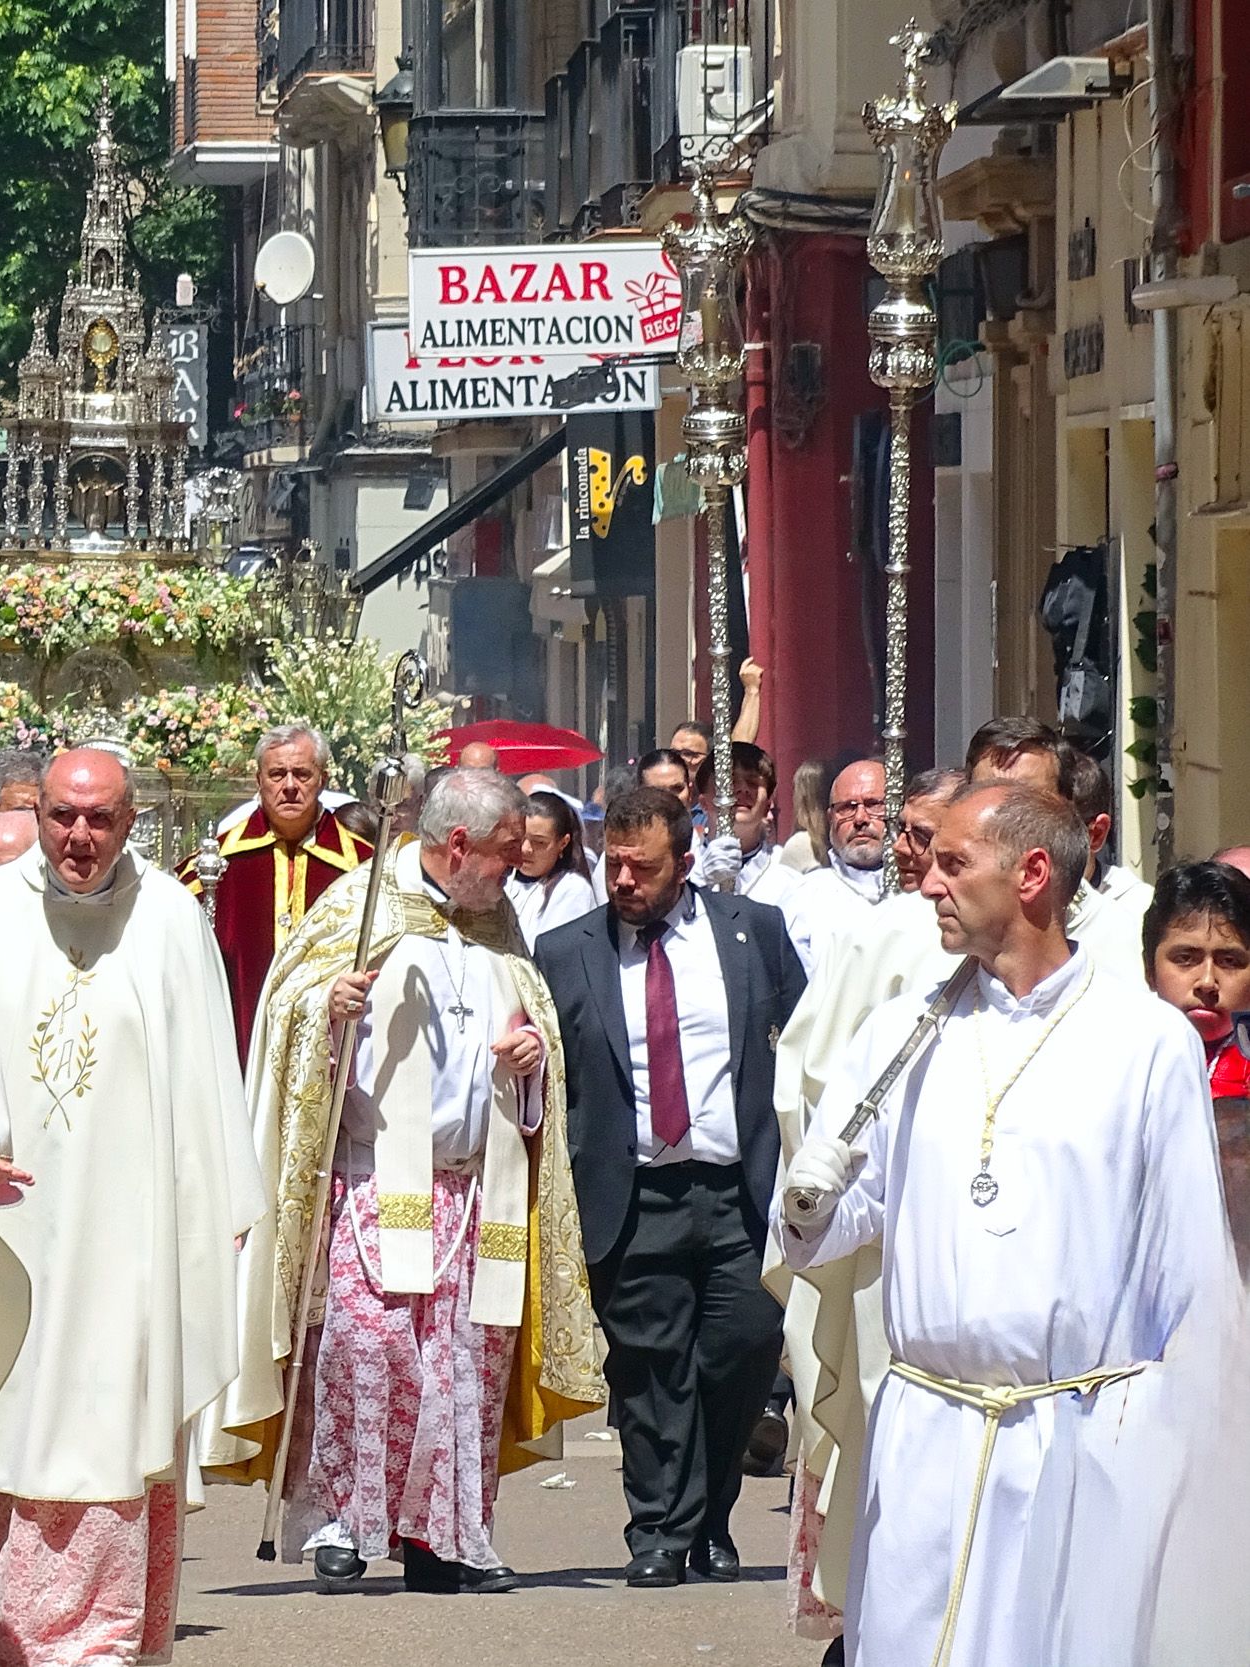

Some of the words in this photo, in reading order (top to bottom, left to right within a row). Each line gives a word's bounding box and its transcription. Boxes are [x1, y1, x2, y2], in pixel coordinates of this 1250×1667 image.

[438, 262, 613, 304] BAZAR
[420, 315, 633, 348] ALIMENTACION
[644, 312, 681, 340] REG
[573, 447, 590, 520] rinconada
[576, 525, 590, 540] la
